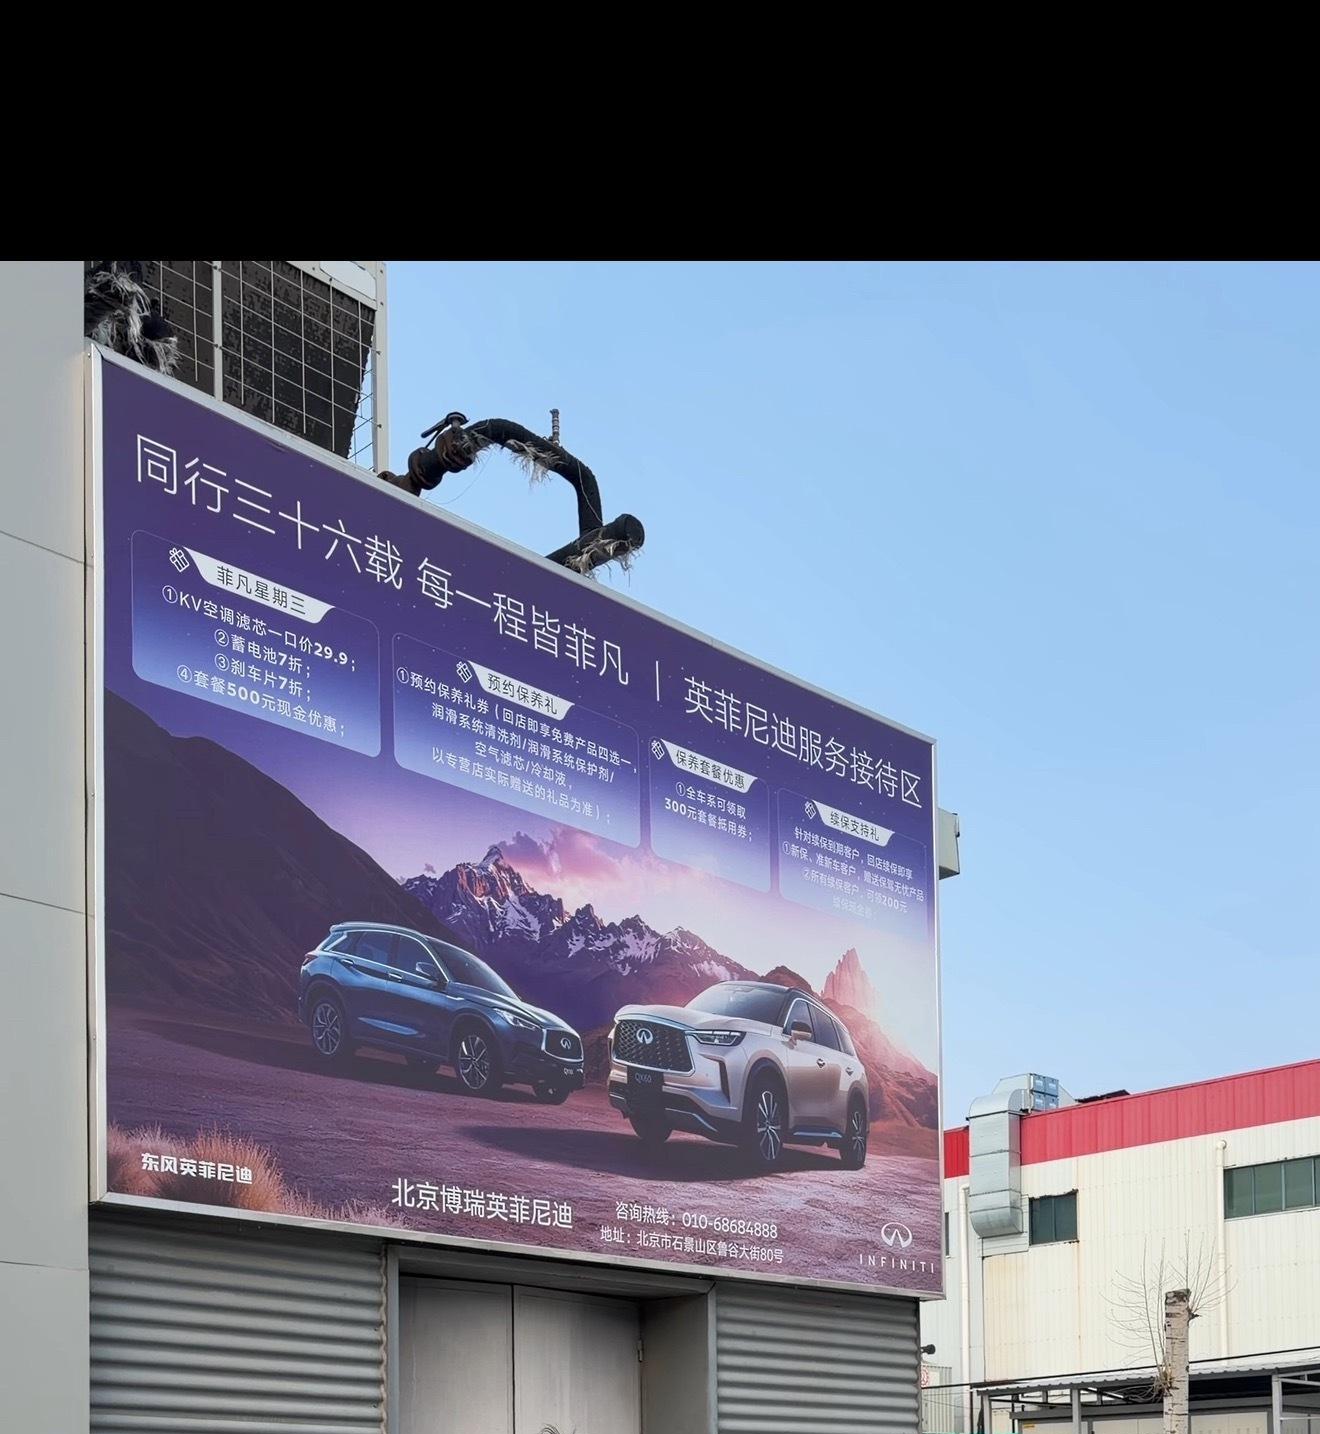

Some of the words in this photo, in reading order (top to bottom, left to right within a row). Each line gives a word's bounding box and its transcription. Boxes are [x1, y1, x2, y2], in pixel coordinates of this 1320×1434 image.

[216, 565, 307, 616] 菲凡星期三
[136, 433, 403, 590] 同行三十六载
[416, 557, 629, 686] 每一程皆菲凡
[684, 676, 923, 808] 英菲尼迪服务接待区
[214, 629, 311, 679] ②蓄电池7折；
[214, 653, 311, 702] ③刹车片7折；
[487, 673, 557, 714] 预约保养礼
[431, 702, 614, 783] 润滑系统清洗剂/润滑系统保护剂/
[676, 749, 745, 789] 保养套餐优惠
[676, 781, 746, 819] ①全车系可领取
[830, 811, 880, 842] 续保支持礼
[141, 1151, 253, 1185] 东风英菲尼迪
[391, 1177, 574, 1230] 北京博瑞英菲尼迪
[859, 1253, 935, 1274] INFINITI
